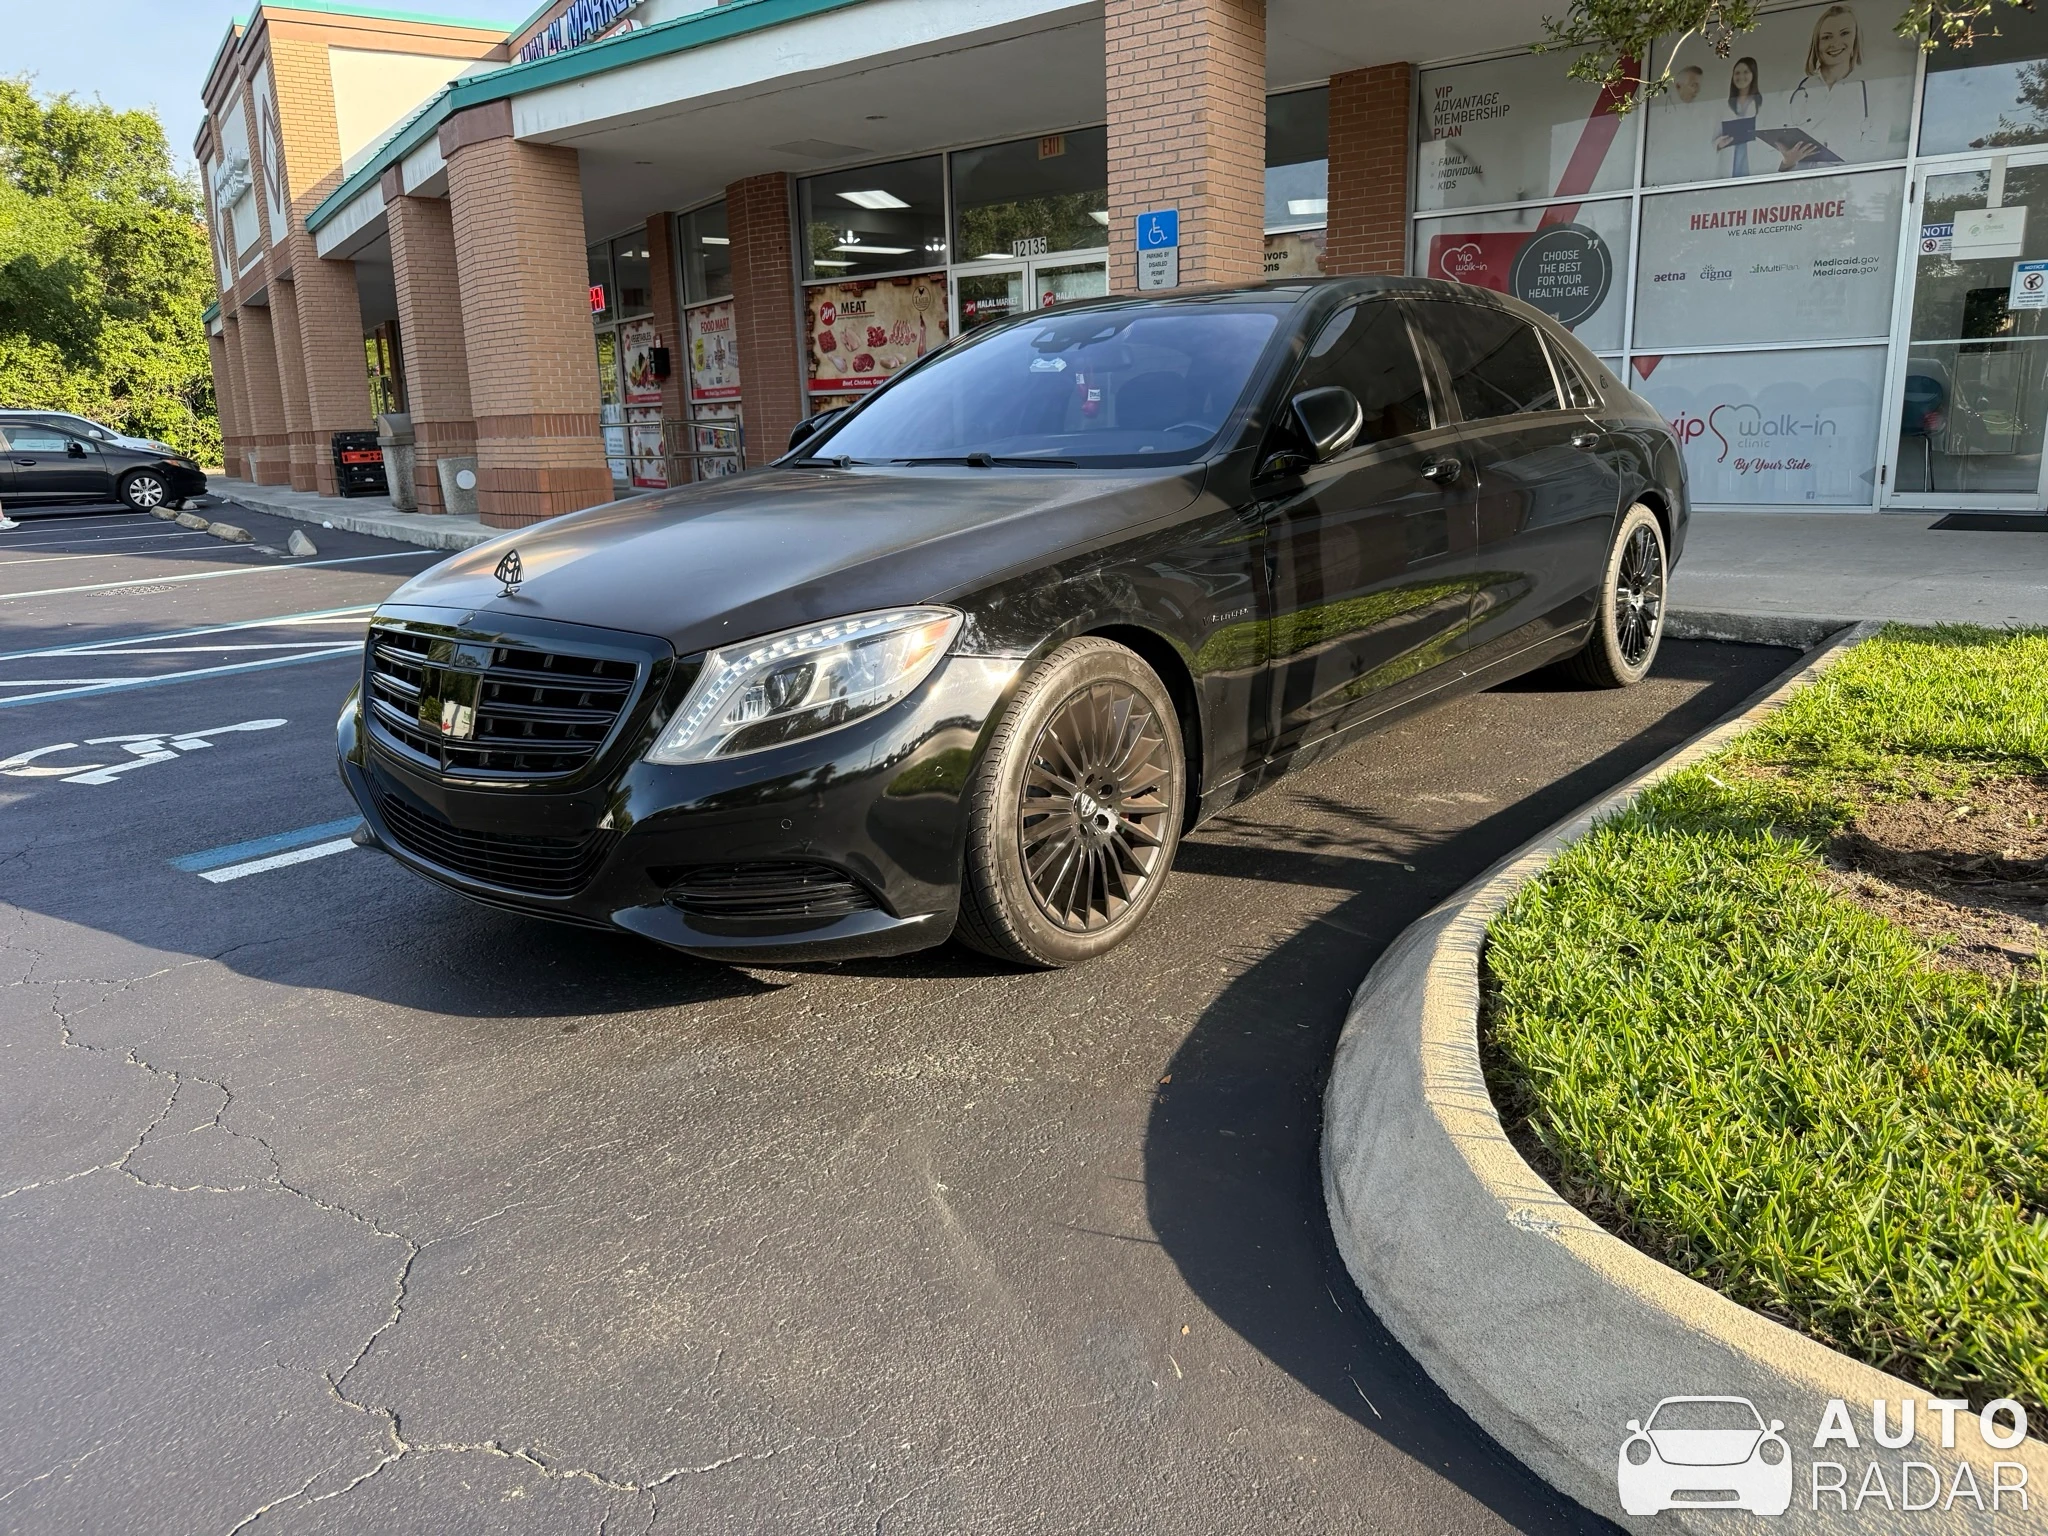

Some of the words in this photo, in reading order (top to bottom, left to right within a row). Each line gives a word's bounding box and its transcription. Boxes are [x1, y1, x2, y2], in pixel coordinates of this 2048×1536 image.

[567, 0, 640, 49] MARK
[1435, 85, 1453, 99] VIP
[1433, 92, 1500, 113] ADVANTAGE
[1434, 104, 1510, 127] MEMBERSHIP
[1434, 125, 1462, 140] PLAN
[1043, 136, 1062, 156] EXIT
[1438, 155, 1468, 167] FAMILY
[1437, 165, 1484, 179] INDIVIDUAL
[1437, 180, 1457, 191] KIDS
[1690, 209, 1747, 231] HEALTH
[1752, 200, 1846, 225] INSURANCE
[1727, 229, 1740, 237] WE
[1742, 228, 1757, 236] ARE
[1758, 224, 1803, 234] ACCEPTING
[1922, 225, 1953, 237] NOTI
[1014, 237, 1046, 258] 12135
[1457, 251, 1473, 264] vip
[1543, 250, 1579, 262] CHOOSE
[1813, 255, 1880, 268] Medicaid.gov
[1455, 262, 1488, 271] walk-in
[1539, 263, 1557, 274] THE
[1559, 261, 1582, 273] BEST
[1759, 264, 1800, 274] MultiPlan
[1812, 265, 1879, 278] Medicare.gov
[1537, 276, 1555, 286] FOR
[1557, 274, 1582, 285] YOUR
[1653, 272, 1686, 283] aetna
[1700, 267, 1732, 282] cigna
[1055, 291, 1077, 301] HALAL
[1528, 287, 1564, 298] HEALTH
[1565, 286, 1590, 297] CARE
[841, 300, 867, 314] MEAT
[976, 299, 996, 309] HALAL
[700, 319, 714, 333] FOOD
[715, 317, 730, 331] MART
[1739, 414, 1837, 437] walk-in
[1737, 438, 1770, 448] clinic
[1733, 457, 1751, 475] By
[1751, 457, 1784, 474] Your
[1784, 457, 1812, 471] Side
